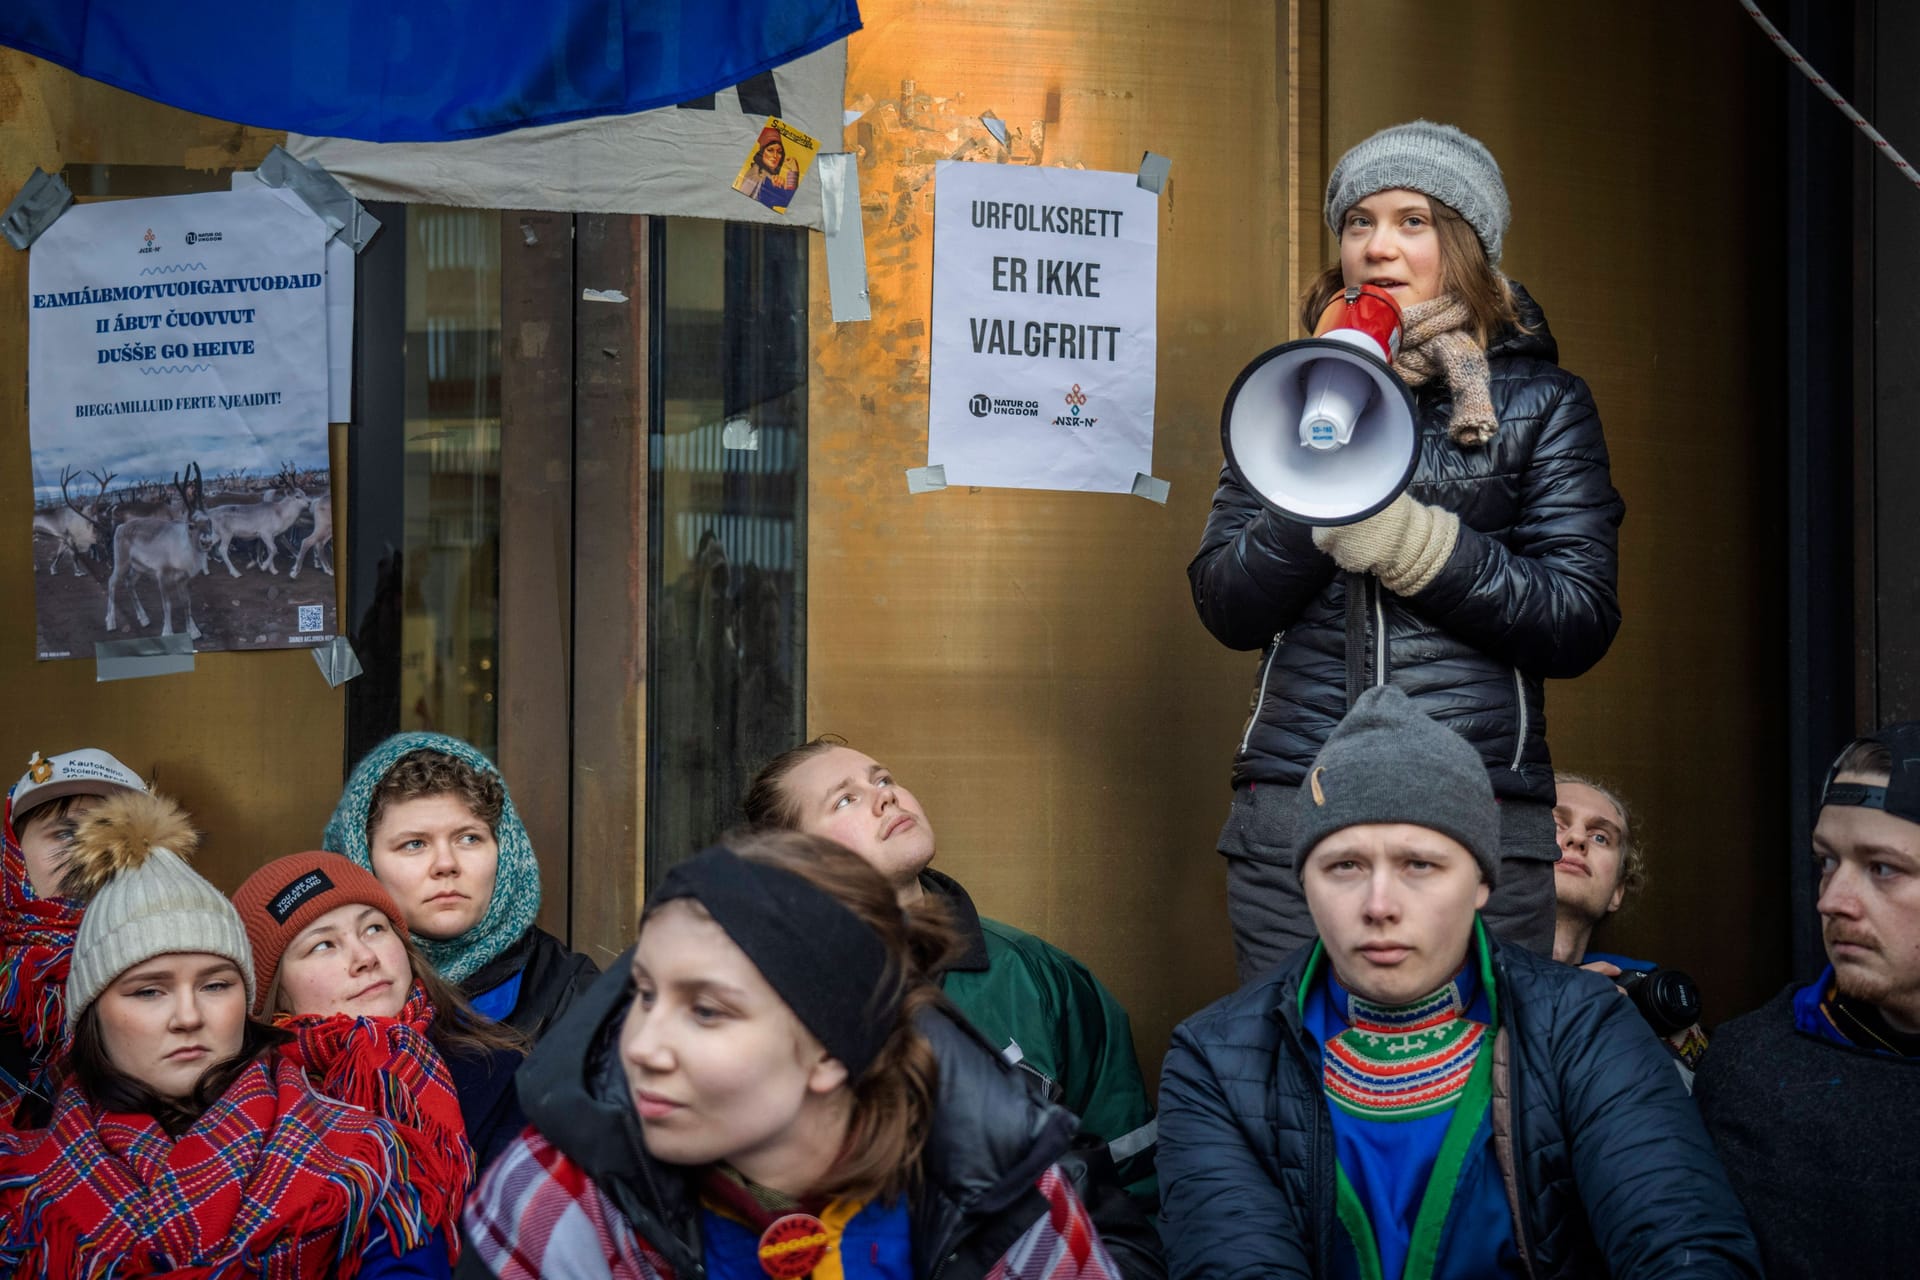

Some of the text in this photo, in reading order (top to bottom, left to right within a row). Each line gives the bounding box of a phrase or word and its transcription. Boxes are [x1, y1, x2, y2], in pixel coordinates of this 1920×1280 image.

[972, 200, 1123, 238] URFOLKSRETT
[993, 256, 1101, 298] ER IKKE
[96, 309, 255, 333] II ÁBUT ČUOVVUT
[97, 340, 255, 364] DUŠŠE GO HEIVE
[970, 318, 1120, 361] VALGFRITT
[75, 392, 282, 418] BIEGGAMILLUID FERTE NJEAIDIT!
[993, 407, 1038, 417] UNGDOM
[994, 399, 1039, 409] NATUR OG
[69, 760, 123, 777] Kautokeino
[277, 874, 318, 908] YOU ARE ON
[279, 878, 322, 915] NATIVE LAND
